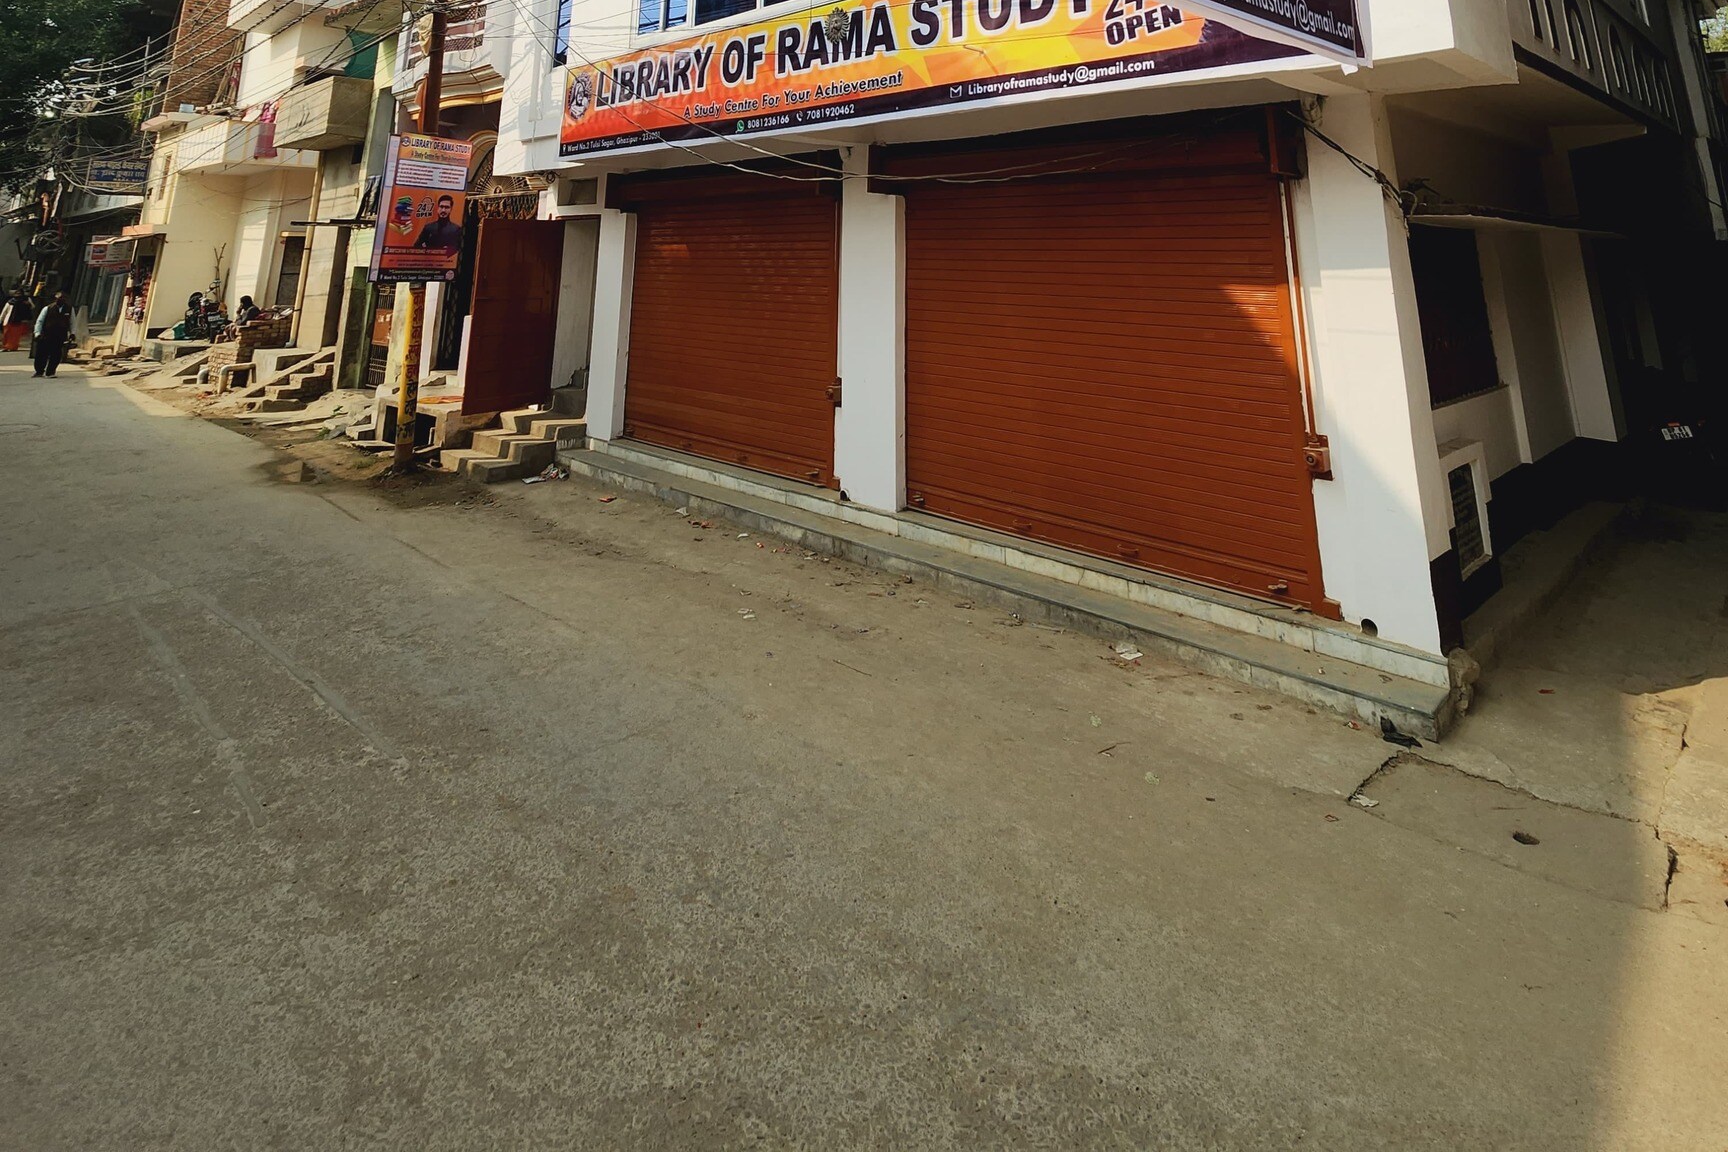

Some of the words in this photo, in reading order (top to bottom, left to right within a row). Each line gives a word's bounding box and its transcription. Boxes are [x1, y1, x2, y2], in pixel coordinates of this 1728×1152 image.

[1105, 4, 1182, 45] OPEN
[595, 44, 715, 108] LIBRARY
[721, 33, 767, 85] OF
[776, 3, 897, 74] RAMA
[683, 107, 691, 119] A
[694, 102, 721, 119] Study
[724, 98, 758, 113] Centre
[762, 93, 780, 108] For
[783, 89, 811, 105] Your
[814, 70, 904, 99] Achievement
[967, 58, 1155, 96] Libraryoframastudy@gmail.com
[747, 114, 790, 129] 8081236166
[806, 103, 855, 120] 7081920462
[411, 138, 433, 149] LIBRARY
